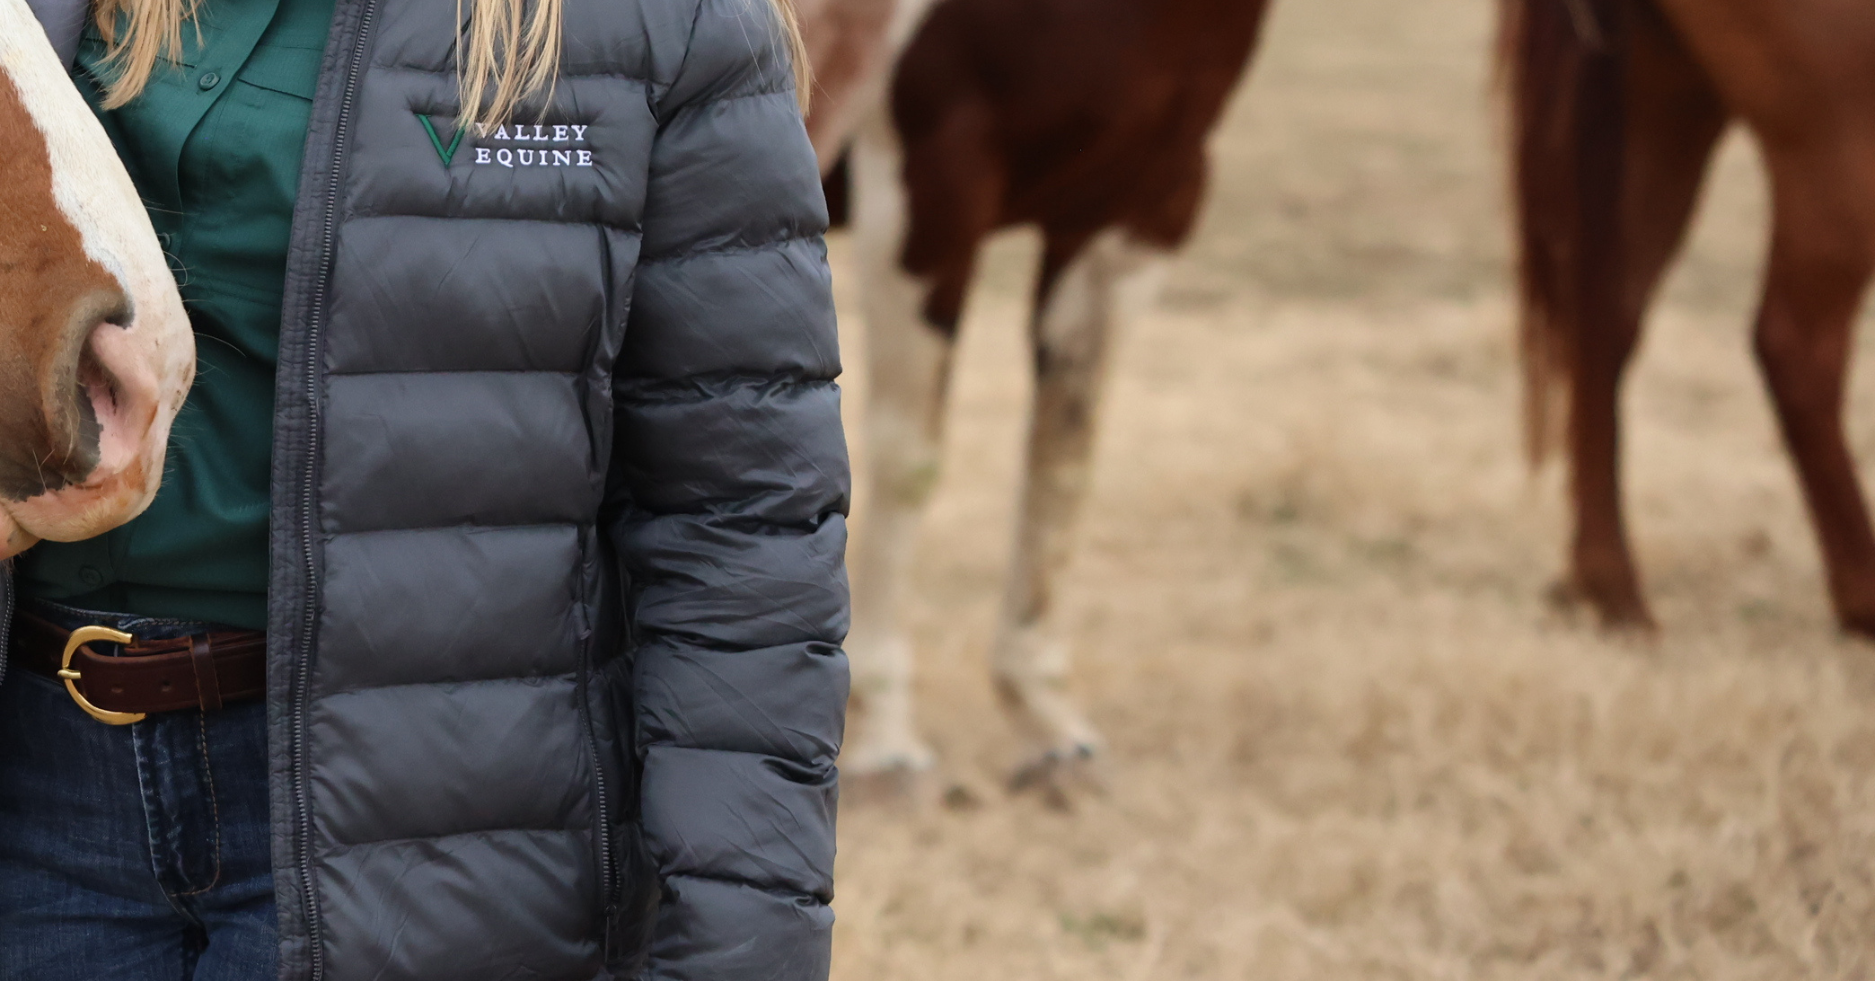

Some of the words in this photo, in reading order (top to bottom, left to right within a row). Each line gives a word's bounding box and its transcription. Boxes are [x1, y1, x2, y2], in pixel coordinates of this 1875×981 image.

[414, 114, 468, 166] V
[475, 122, 588, 141] VALLEY
[475, 148, 593, 167] EQUINE
